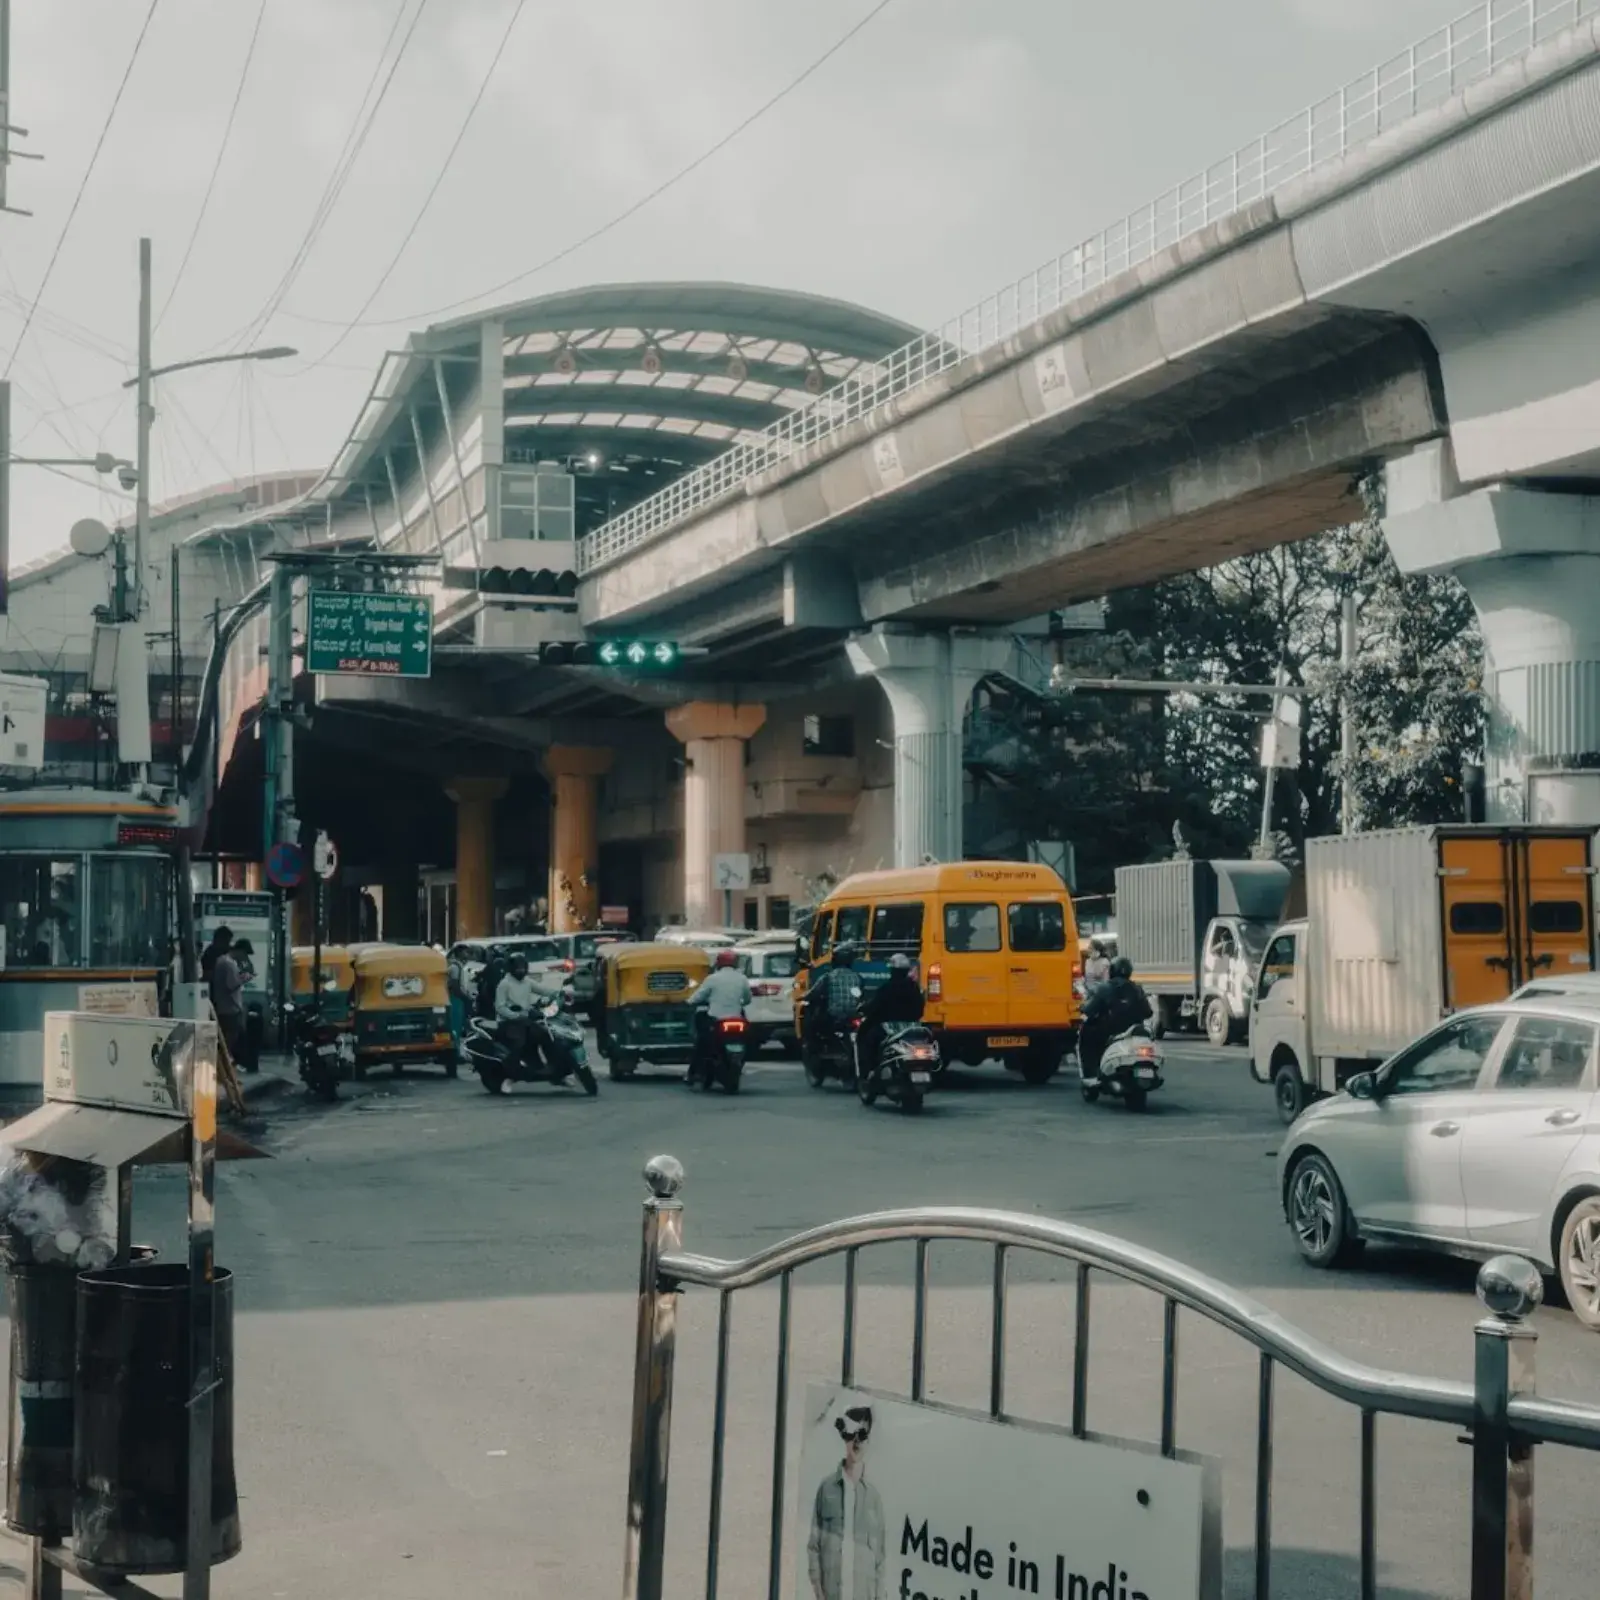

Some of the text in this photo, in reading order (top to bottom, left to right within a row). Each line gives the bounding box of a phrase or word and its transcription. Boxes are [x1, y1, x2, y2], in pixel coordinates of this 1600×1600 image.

[388, 618, 404, 632] Road
[385, 640, 401, 654] Road
[370, 661, 400, 672] B-TRAC
[900, 1514, 994, 1579] Made
[1008, 1541, 1038, 1593] in
